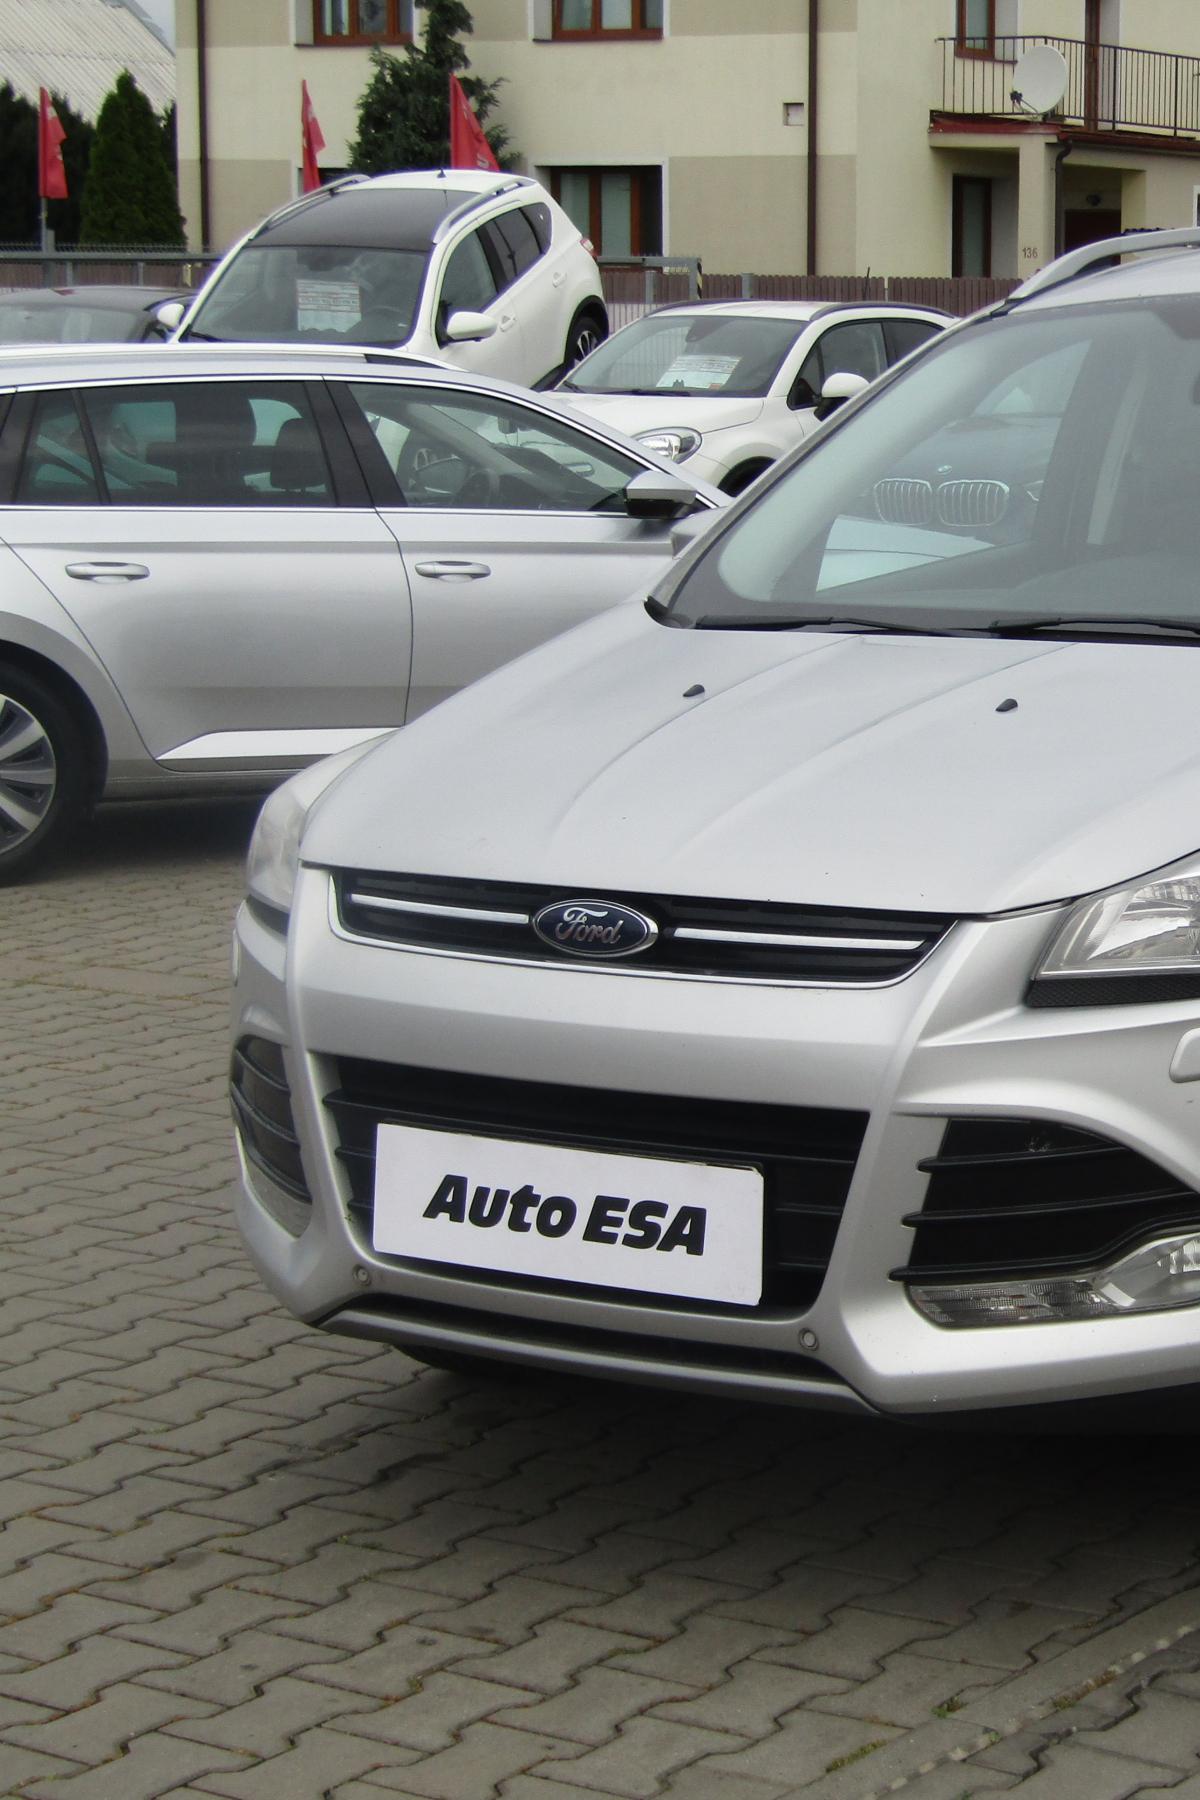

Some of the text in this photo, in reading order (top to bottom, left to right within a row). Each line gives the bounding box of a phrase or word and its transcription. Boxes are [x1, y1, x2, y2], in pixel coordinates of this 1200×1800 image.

[1022, 247, 1039, 259] 136
[555, 907, 624, 944] Ford
[423, 1174, 707, 1256] Auto ESA
